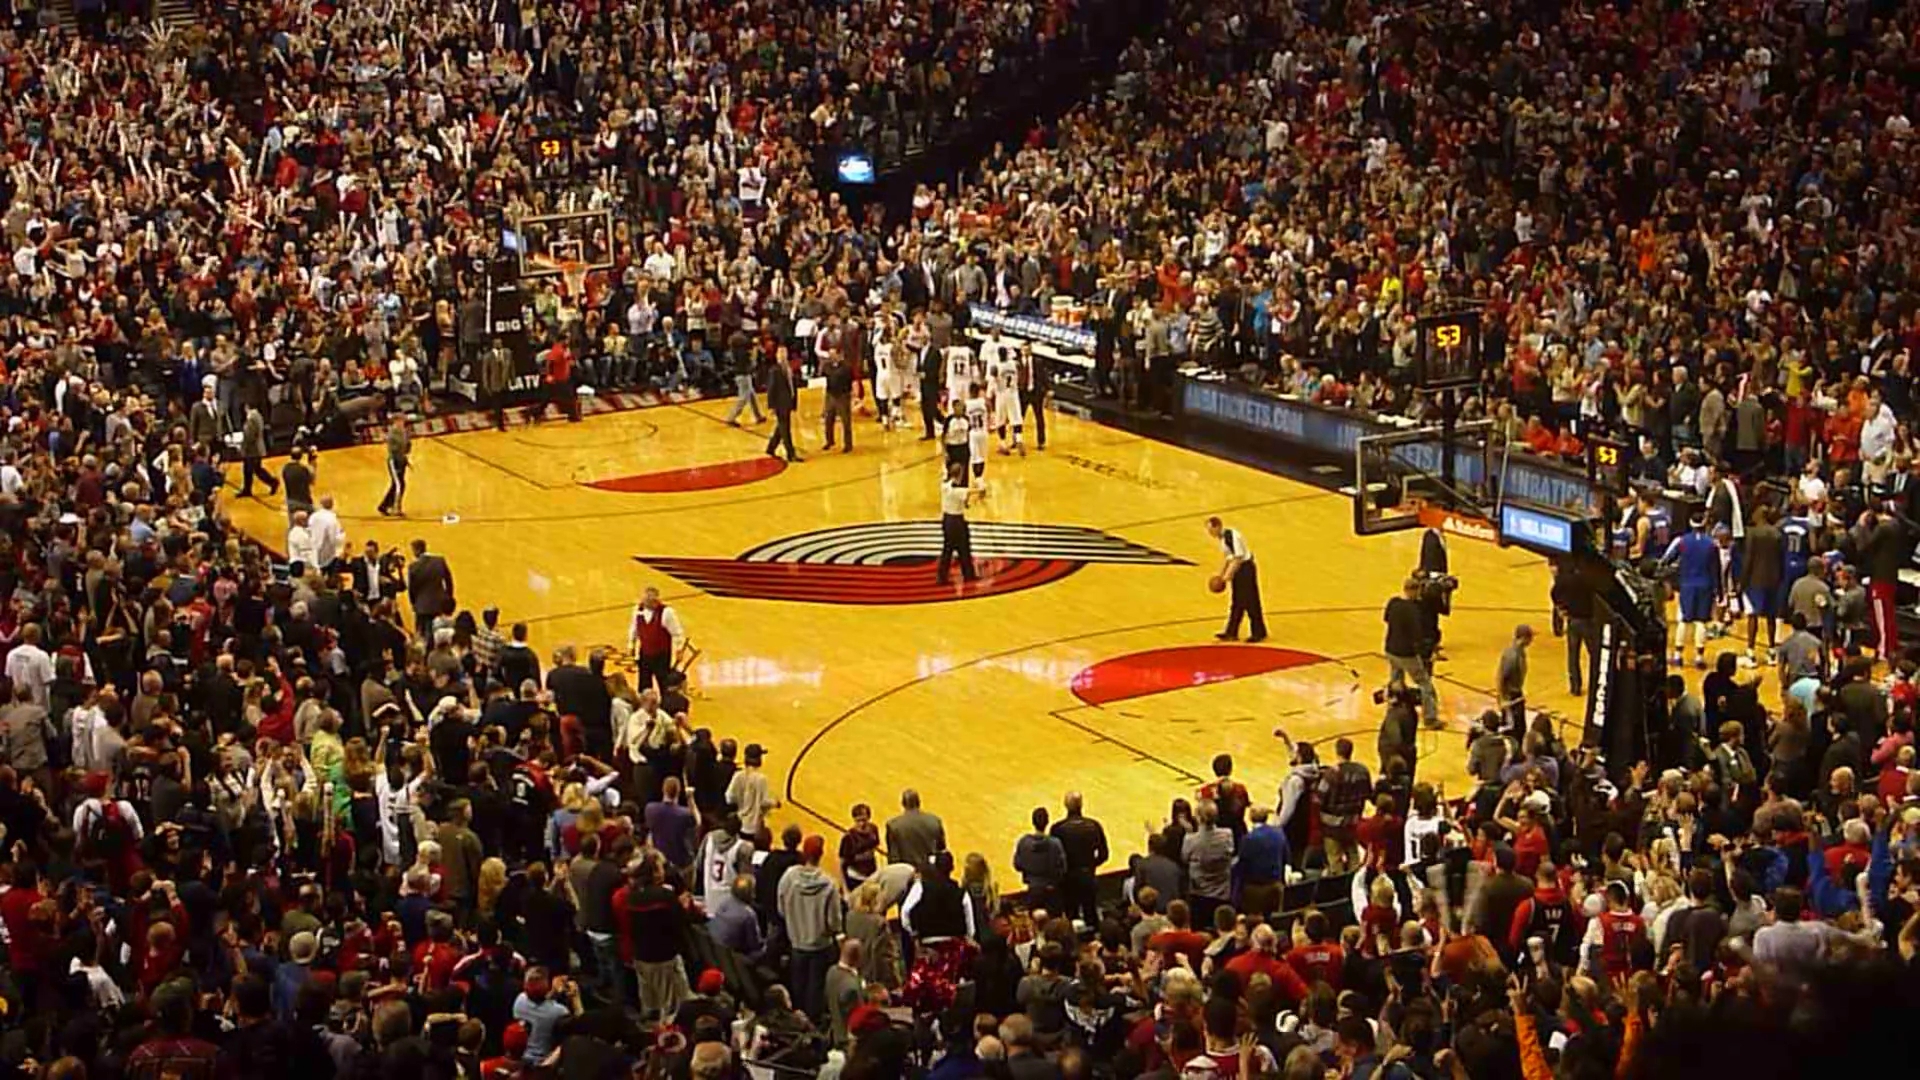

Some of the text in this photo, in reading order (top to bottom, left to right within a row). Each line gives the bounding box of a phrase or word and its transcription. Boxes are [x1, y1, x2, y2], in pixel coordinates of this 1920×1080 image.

[541, 140, 560, 156] 53
[1436, 324, 1461, 347] 53
[1599, 445, 1617, 465] 53
[712, 860, 726, 883] 3
[1548, 923, 1561, 943] 7
